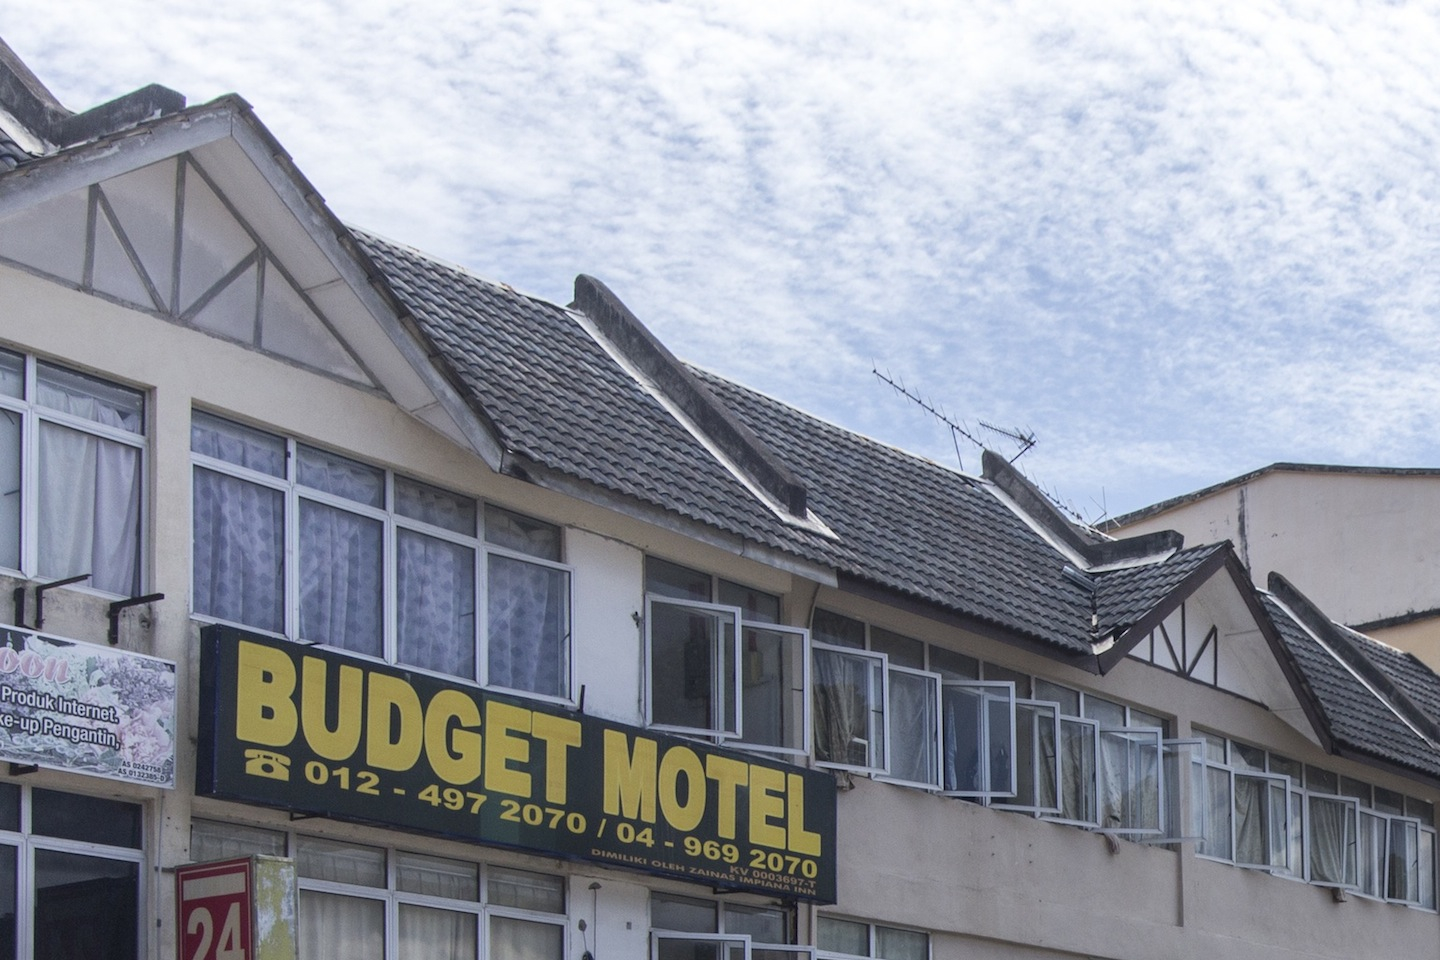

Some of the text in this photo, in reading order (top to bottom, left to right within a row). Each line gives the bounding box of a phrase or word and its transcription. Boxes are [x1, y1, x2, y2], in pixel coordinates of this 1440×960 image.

[1, 685, 120, 724] Produk Internet.
[43, 718, 121, 750] Pengantin,
[236, 640, 821, 857] BUDGET MOTEL
[304, 761, 380, 795] 012
[418, 784, 487, 815] 497
[500, 800, 587, 834] 2070
[617, 822, 655, 848] 04
[684, 836, 739, 864] 969
[750, 850, 817, 878] 2070
[591, 848, 816, 896] DIMILIKI OLEH ZAINAS IMPIANA INN
[729, 865, 816, 887] KV 0003697-T
